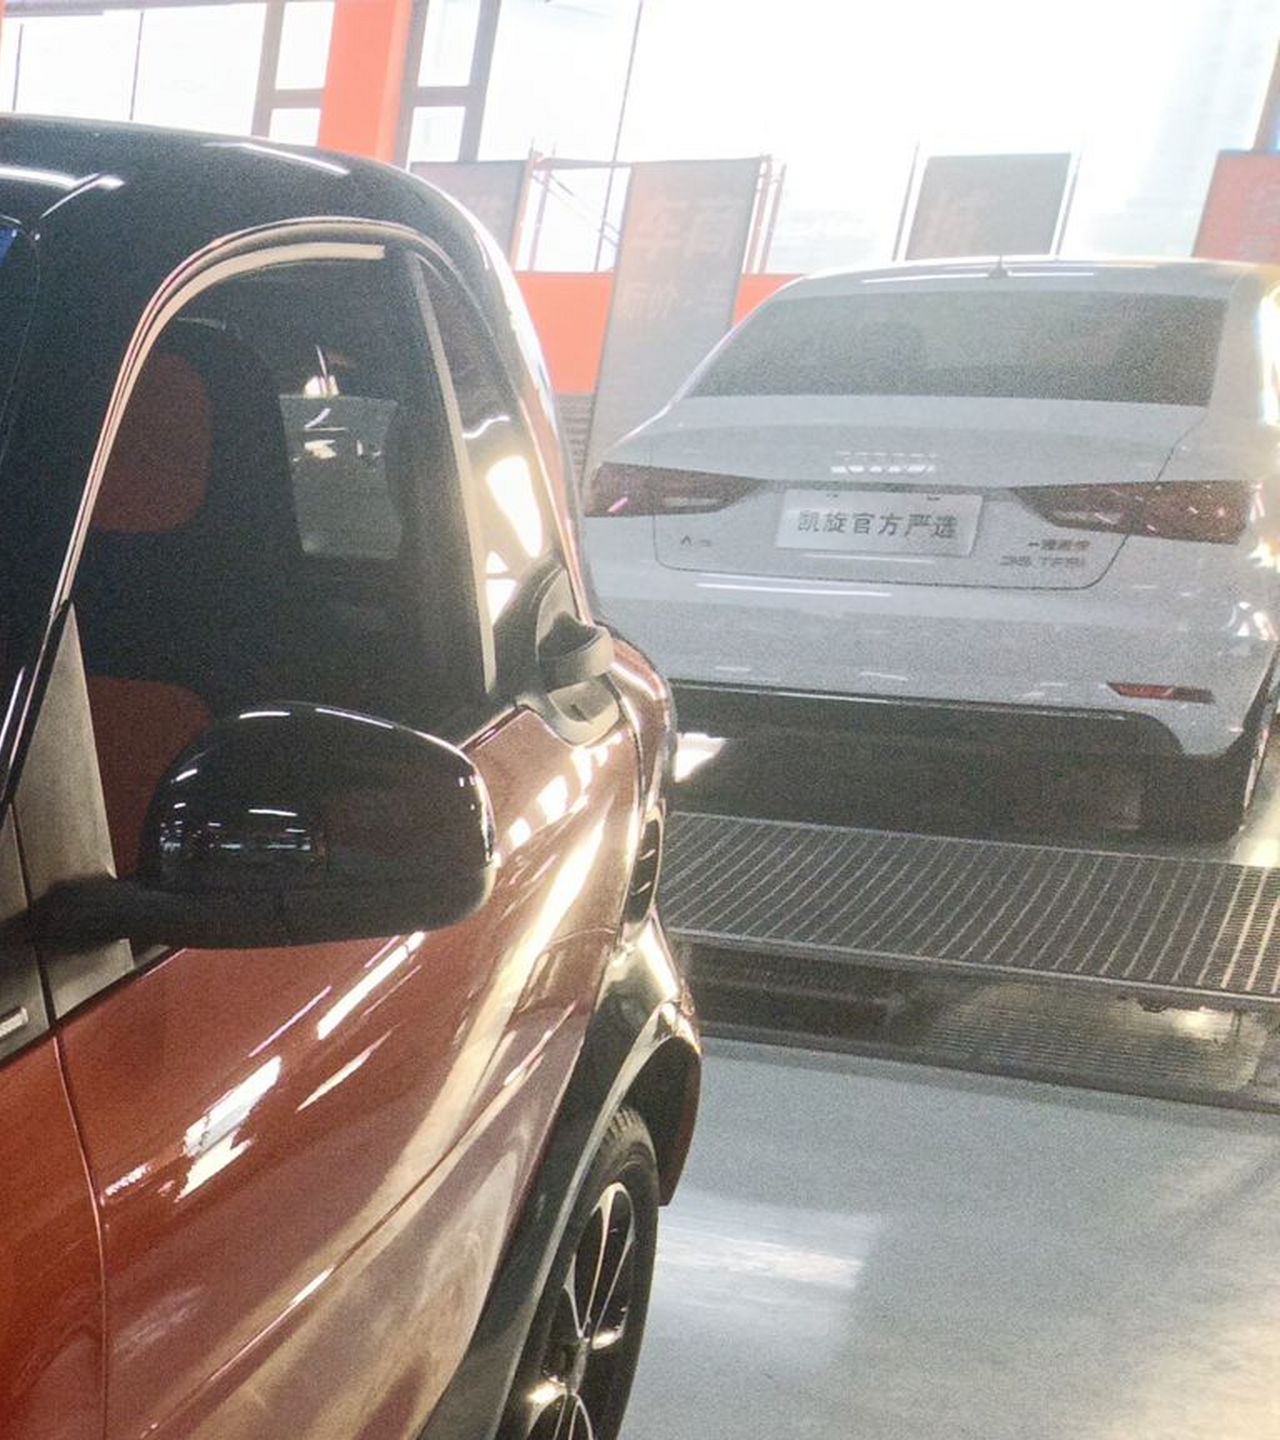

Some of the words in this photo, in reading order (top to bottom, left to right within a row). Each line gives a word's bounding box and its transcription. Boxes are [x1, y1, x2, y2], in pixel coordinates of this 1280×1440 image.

[796, 509, 958, 539] 凯旋官方严选
